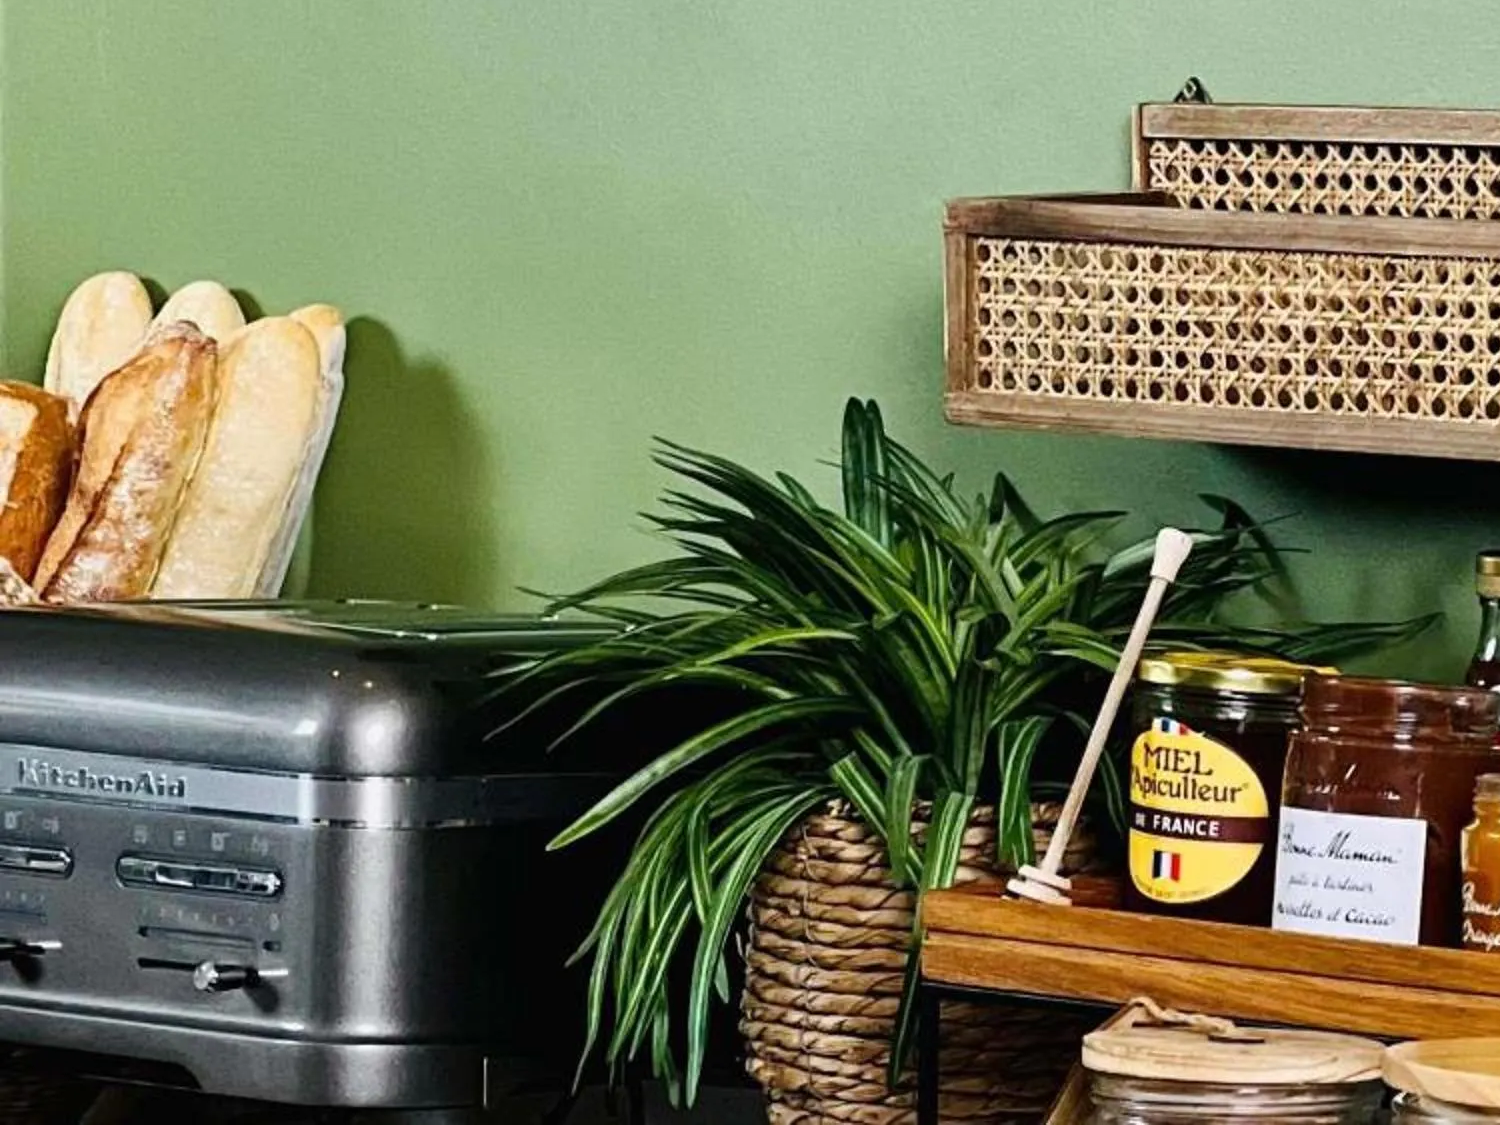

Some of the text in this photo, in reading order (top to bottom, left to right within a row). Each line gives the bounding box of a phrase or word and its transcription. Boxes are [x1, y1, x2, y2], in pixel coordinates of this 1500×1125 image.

[1143, 742, 1214, 776] MIEL
[18, 758, 187, 798] KitchenAid
[1153, 815, 1220, 837] FRANCE
